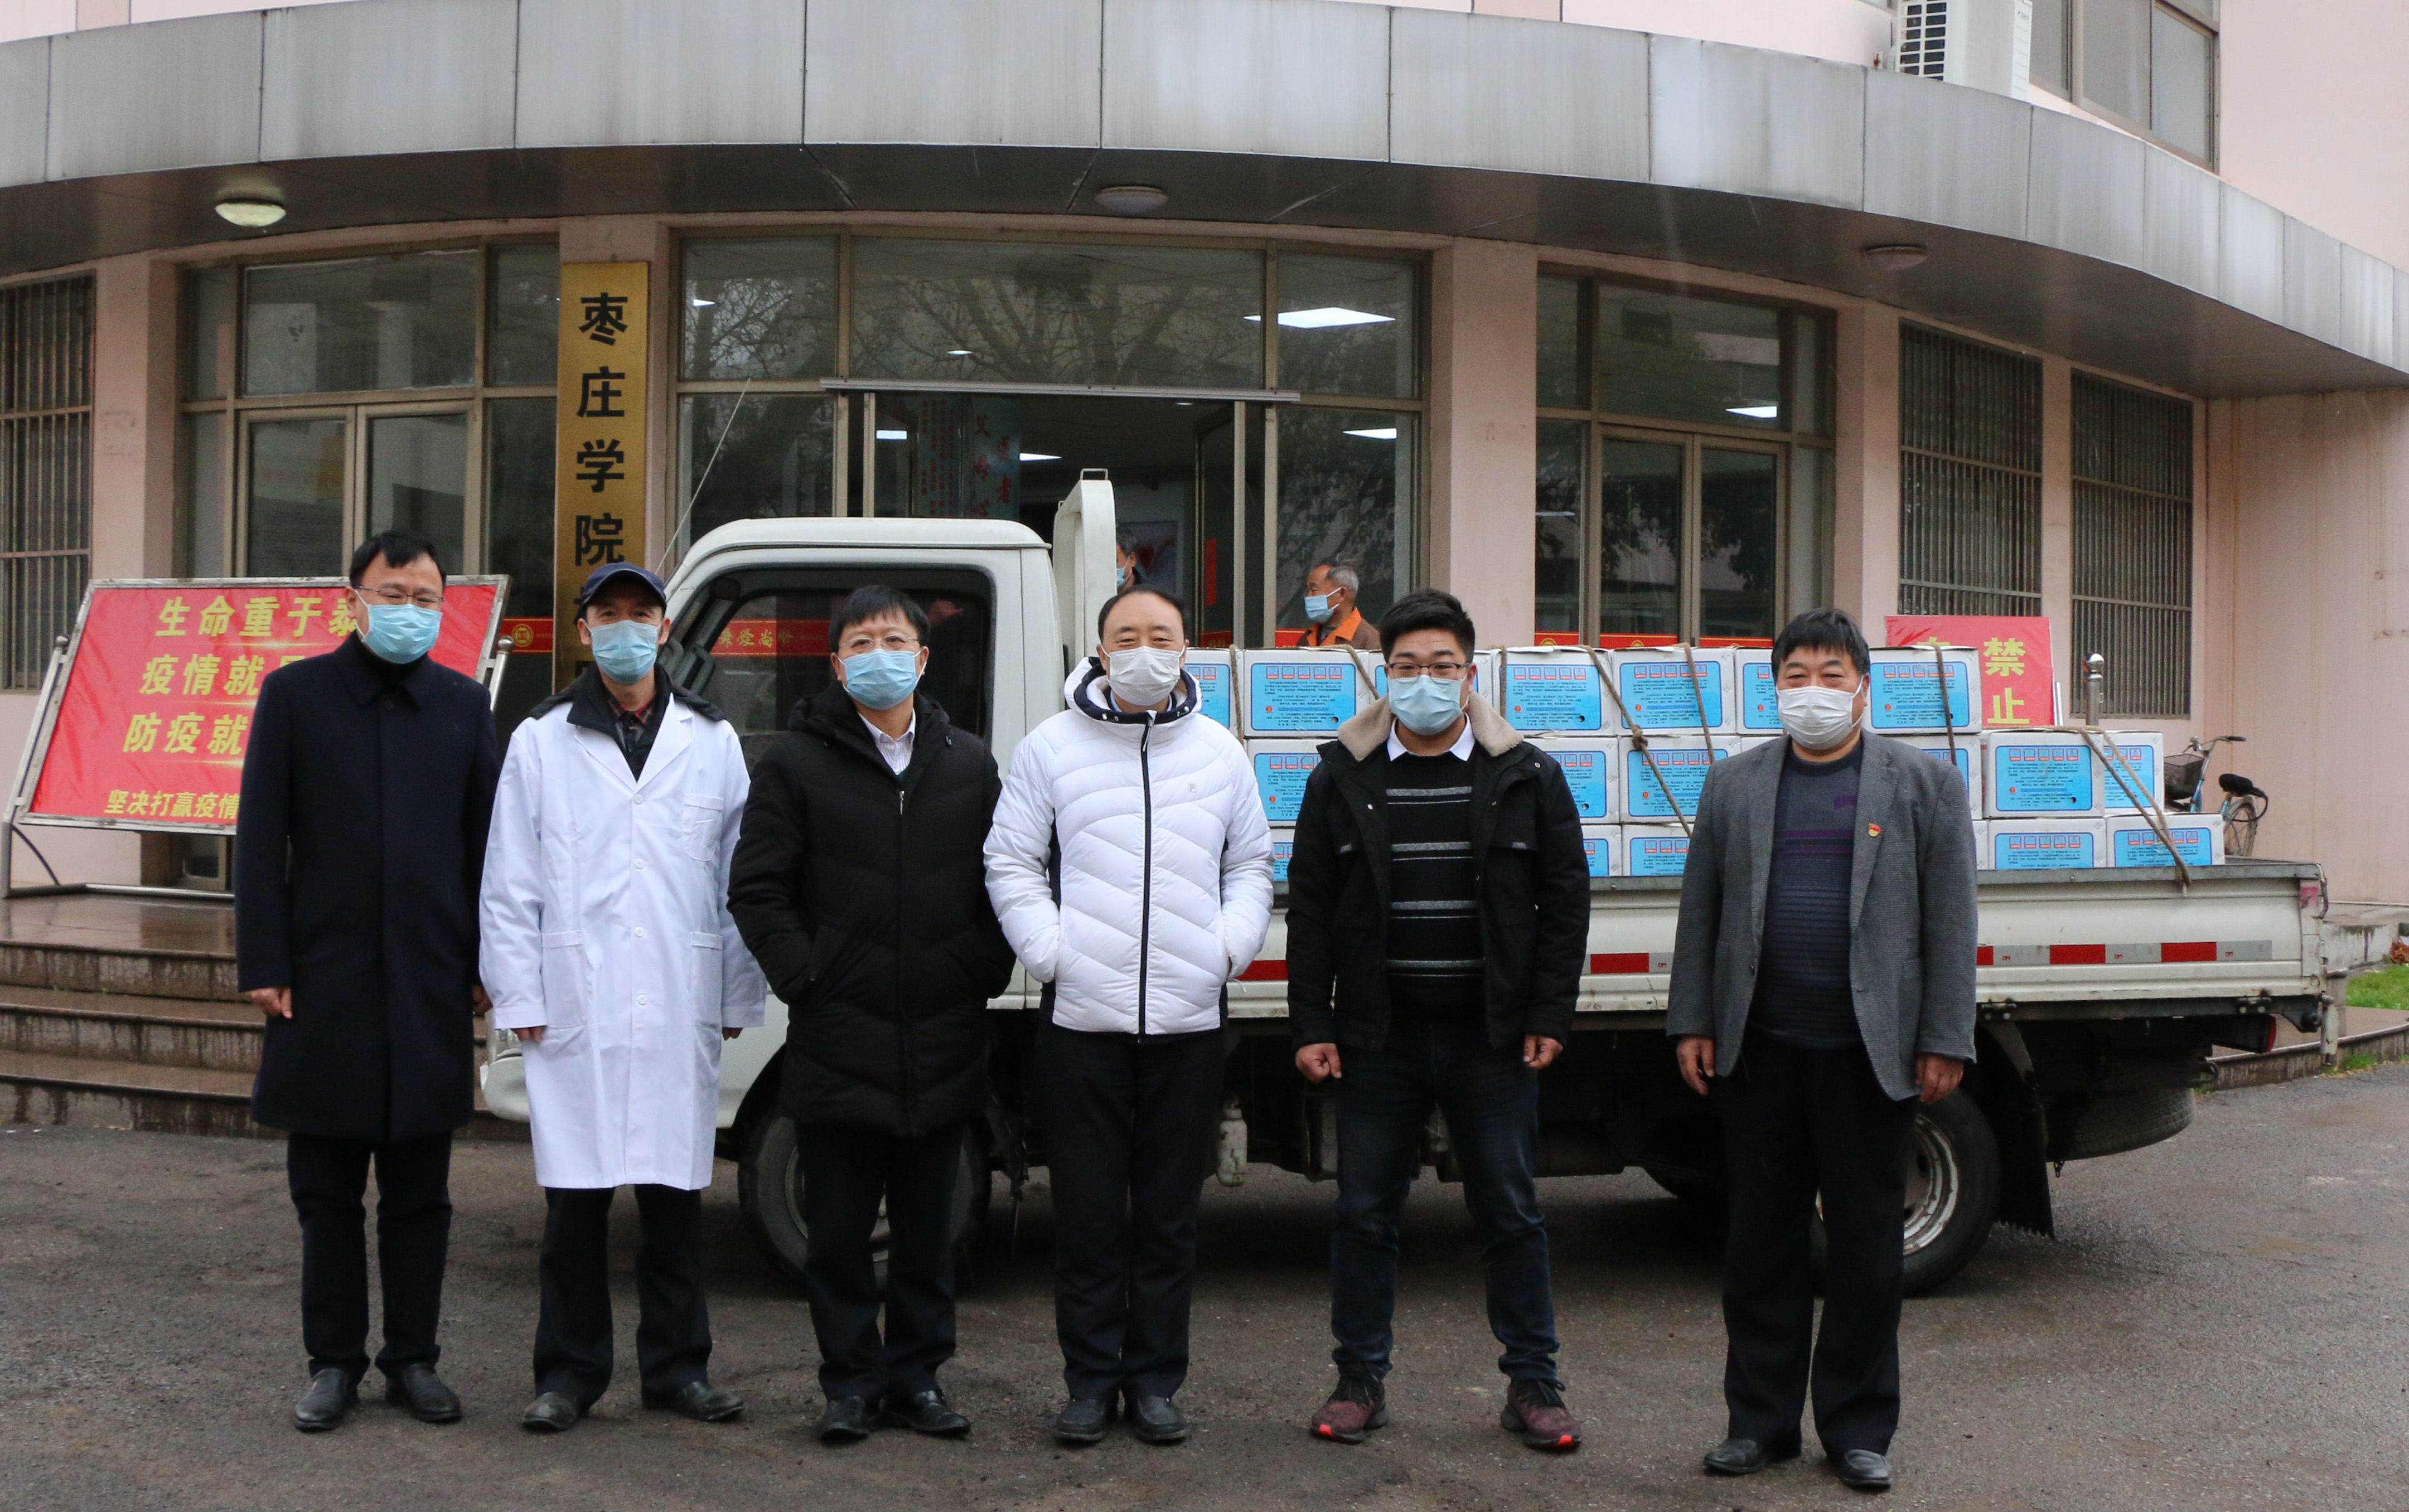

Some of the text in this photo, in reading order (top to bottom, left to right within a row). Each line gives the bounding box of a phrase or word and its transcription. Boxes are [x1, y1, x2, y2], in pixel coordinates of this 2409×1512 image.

[575, 292, 628, 677] 枣庄学院
[123, 712, 249, 755] 防疫就
[104, 789, 240, 819] 坚决打赢疫情
